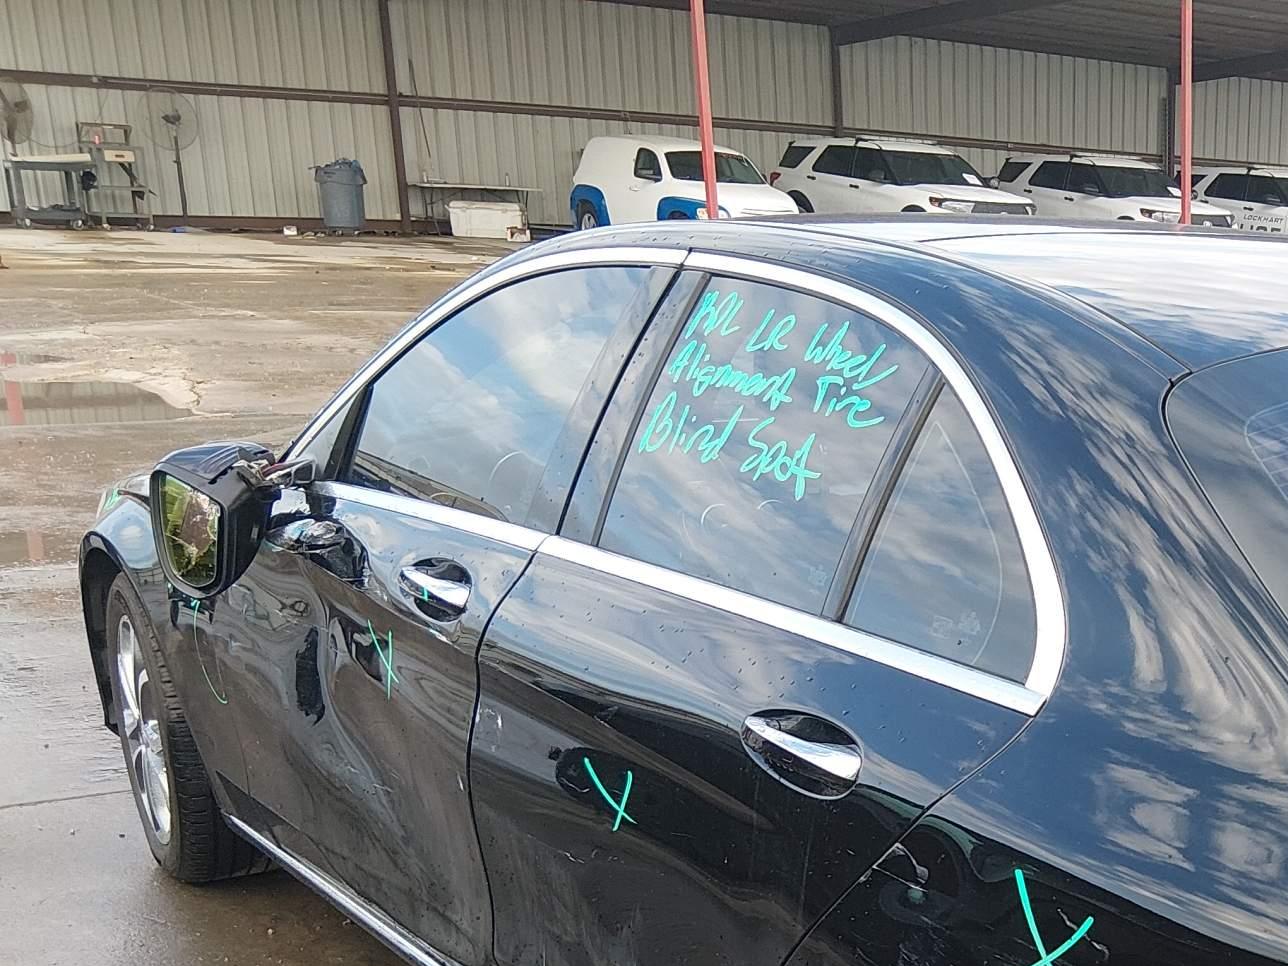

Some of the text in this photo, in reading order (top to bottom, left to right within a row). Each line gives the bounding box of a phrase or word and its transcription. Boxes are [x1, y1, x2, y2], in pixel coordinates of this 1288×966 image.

[1243, 213, 1285, 225] LOCKHART
[804, 320, 899, 390] Wheel
[812, 374, 886, 428] Tire
[638, 390, 822, 501] Blind Spot
